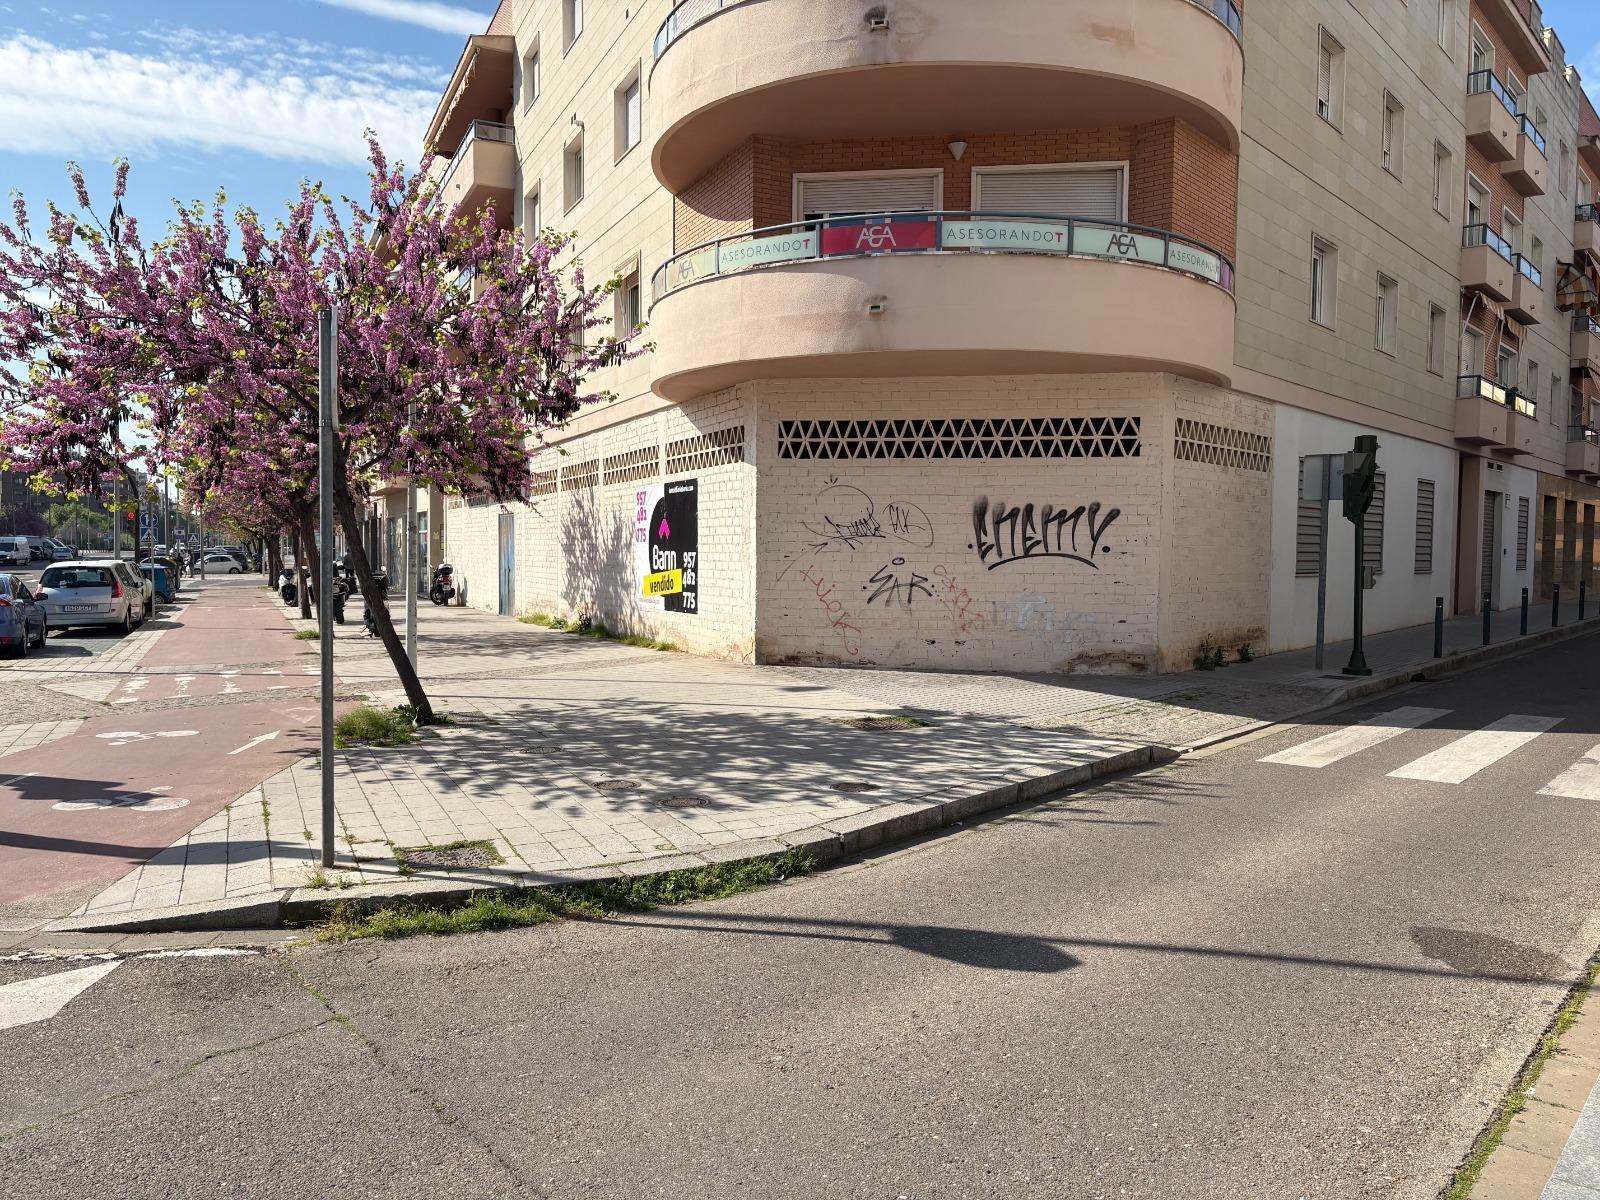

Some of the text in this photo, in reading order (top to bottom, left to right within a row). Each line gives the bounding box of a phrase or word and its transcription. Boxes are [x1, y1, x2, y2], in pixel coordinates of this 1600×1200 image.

[946, 227, 1064, 243] ASESORANDOT
[652, 544, 677, 570] Bann
[682, 551, 697, 568] 957
[650, 574, 674, 594] vendido
[682, 568, 696, 588] 482
[682, 592, 696, 609] 775
